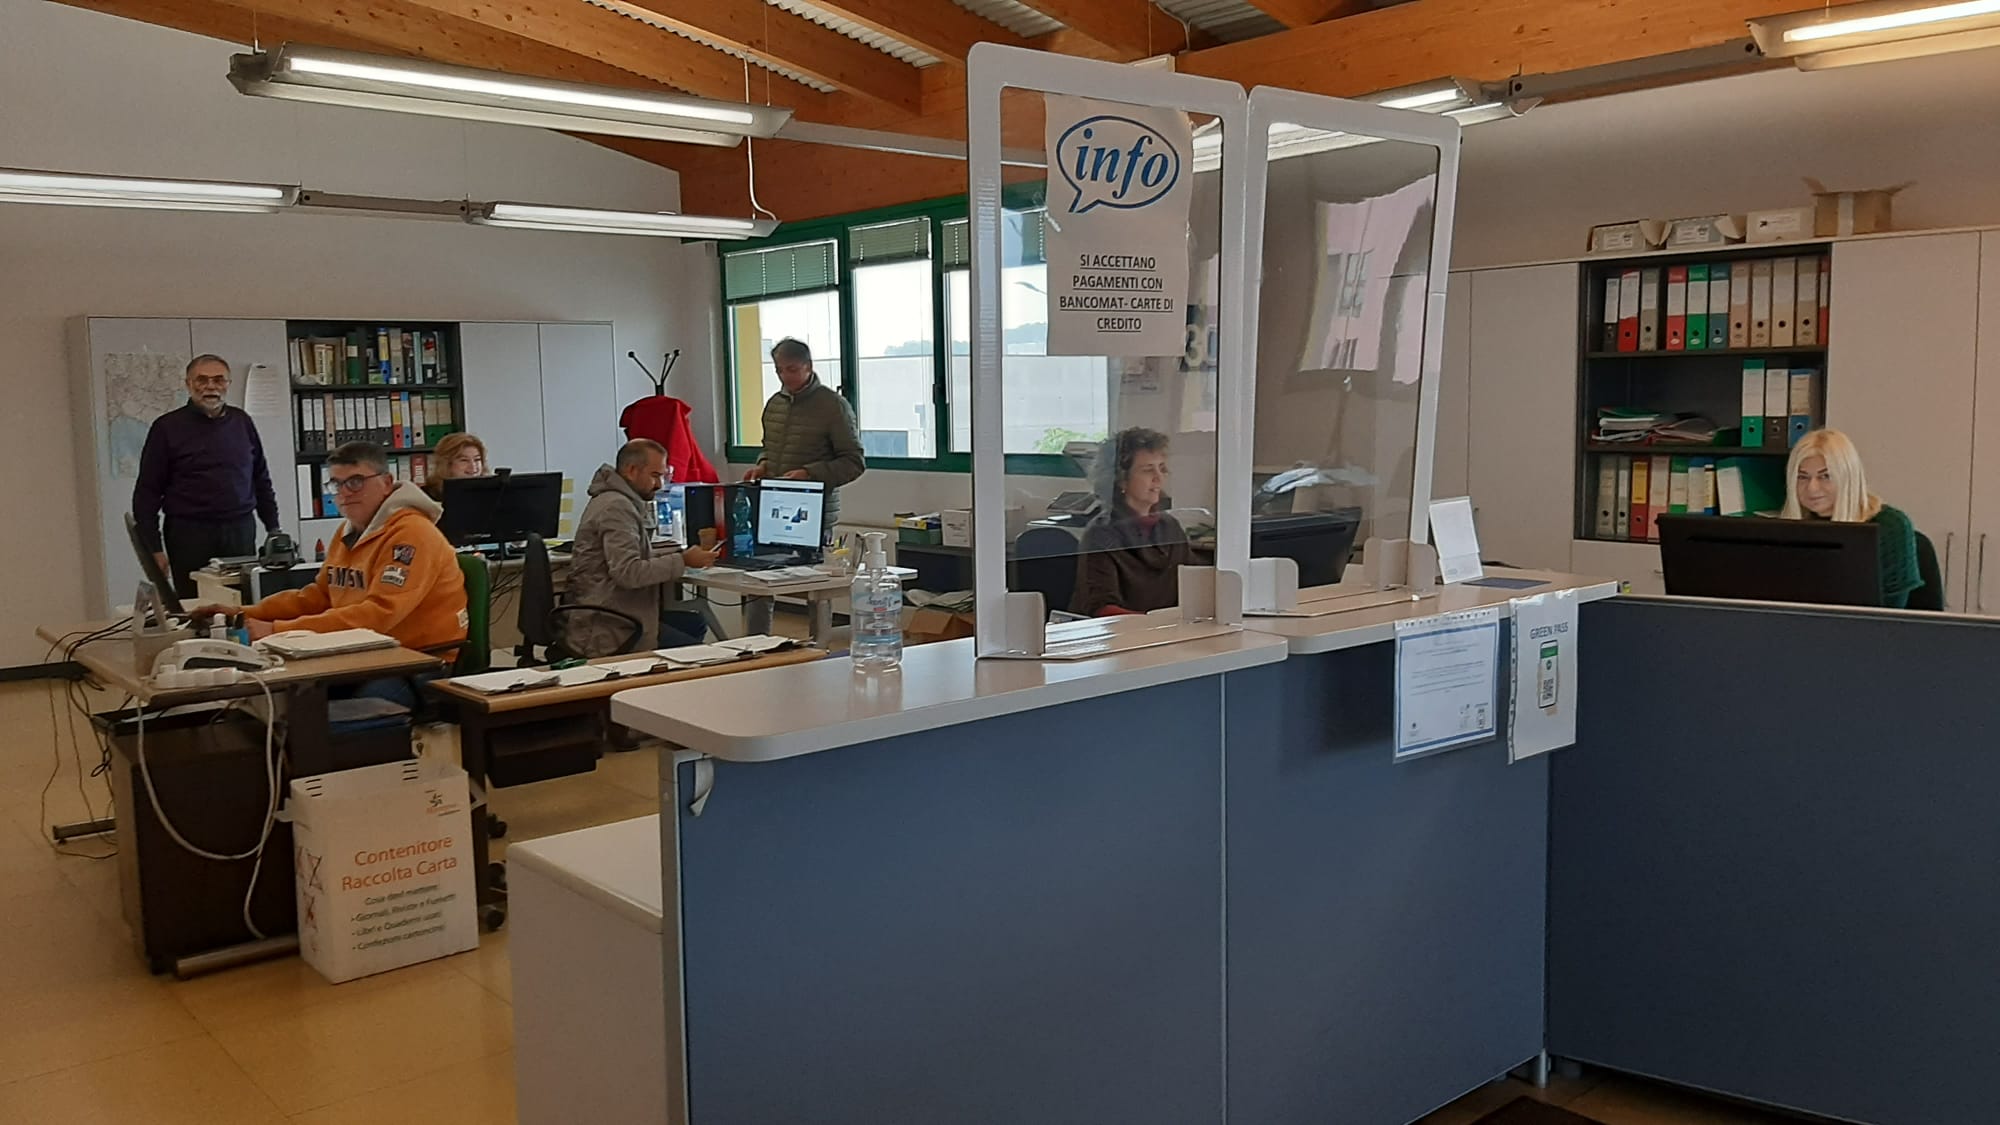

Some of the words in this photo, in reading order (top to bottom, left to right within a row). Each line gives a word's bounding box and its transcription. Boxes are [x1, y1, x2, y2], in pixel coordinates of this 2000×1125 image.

[1075, 127, 1169, 199] info
[1080, 254, 1090, 267] SI
[1093, 255, 1156, 269] ACCETTANO
[1073, 275, 1138, 289] PAGAMENTI
[1141, 276, 1163, 289] CON
[1130, 296, 1161, 310] CARTE
[1164, 297, 1173, 310] DI
[1097, 317, 1142, 330] CREDITO
[1529, 625, 1552, 640] GREEN
[1553, 622, 1569, 634] PASS
[354, 836, 453, 866] Contenitore
[341, 866, 413, 891] Raccolta
[416, 856, 457, 876] Carta
